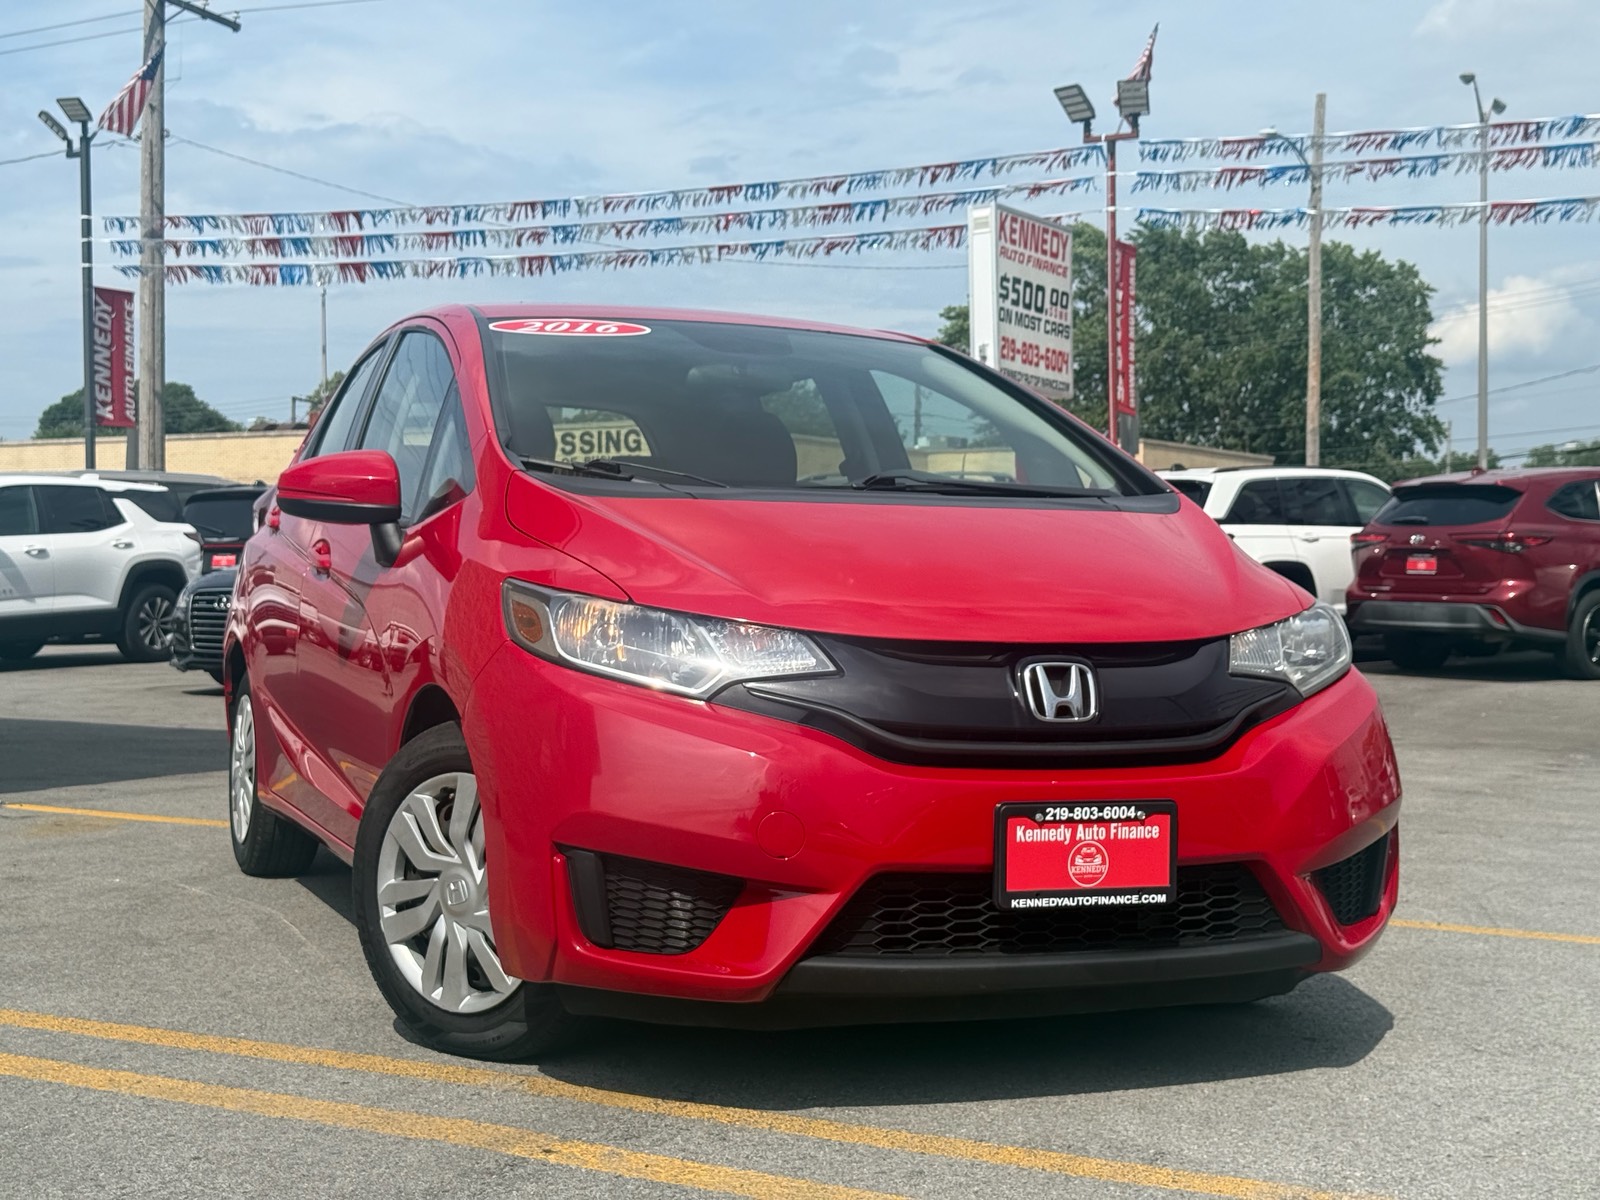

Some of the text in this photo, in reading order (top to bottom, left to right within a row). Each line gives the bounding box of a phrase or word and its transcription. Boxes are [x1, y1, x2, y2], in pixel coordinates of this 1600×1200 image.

[999, 212, 1069, 262] KENNEDY
[999, 246, 1068, 278] AUTO FINANCE
[999, 273, 1069, 316] $500.00
[516, 322, 618, 333] 2016
[998, 307, 1071, 340] ON MOST CARS
[94, 294, 114, 421] KENNEDY
[124, 299, 136, 422] AUTO FINANCE
[1000, 336, 1069, 375] 219-803-6004
[1045, 806, 1136, 821] 219-803-6004
[1016, 823, 1159, 845] Kennedy Auto Finance
[1071, 864, 1106, 874] KENNEDY
[1011, 894, 1167, 908] KENNEDYAUTOFINANCE.COM
